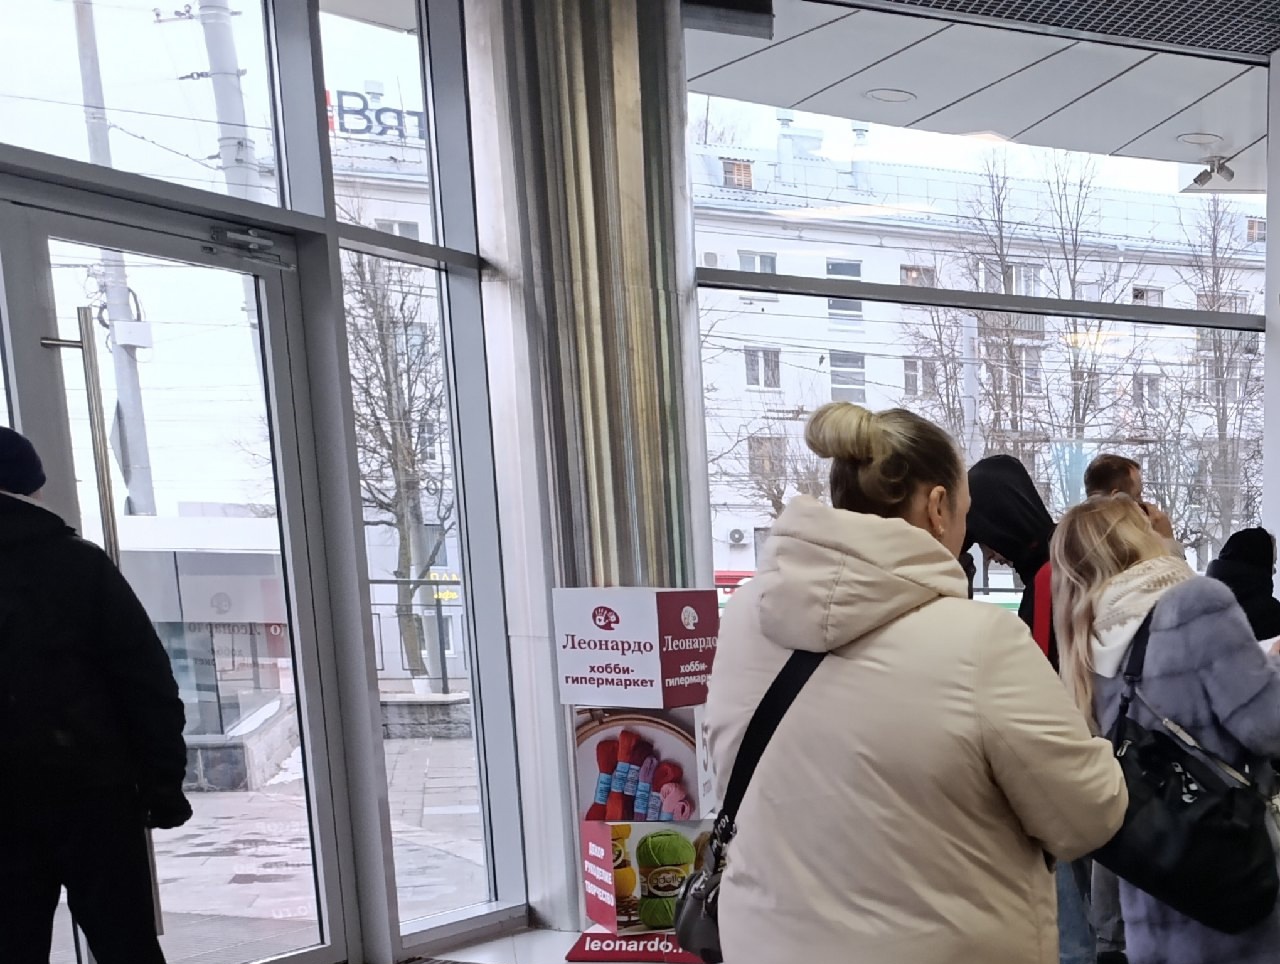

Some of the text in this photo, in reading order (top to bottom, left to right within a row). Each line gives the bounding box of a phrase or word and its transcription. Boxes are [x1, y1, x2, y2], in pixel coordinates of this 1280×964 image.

[562, 634, 654, 656] Леонардо
[663, 635, 718, 652] Леонардо
[589, 664, 635, 675] хобби-
[565, 674, 655, 690] гипермаркет
[584, 936, 684, 954] leonardo.
